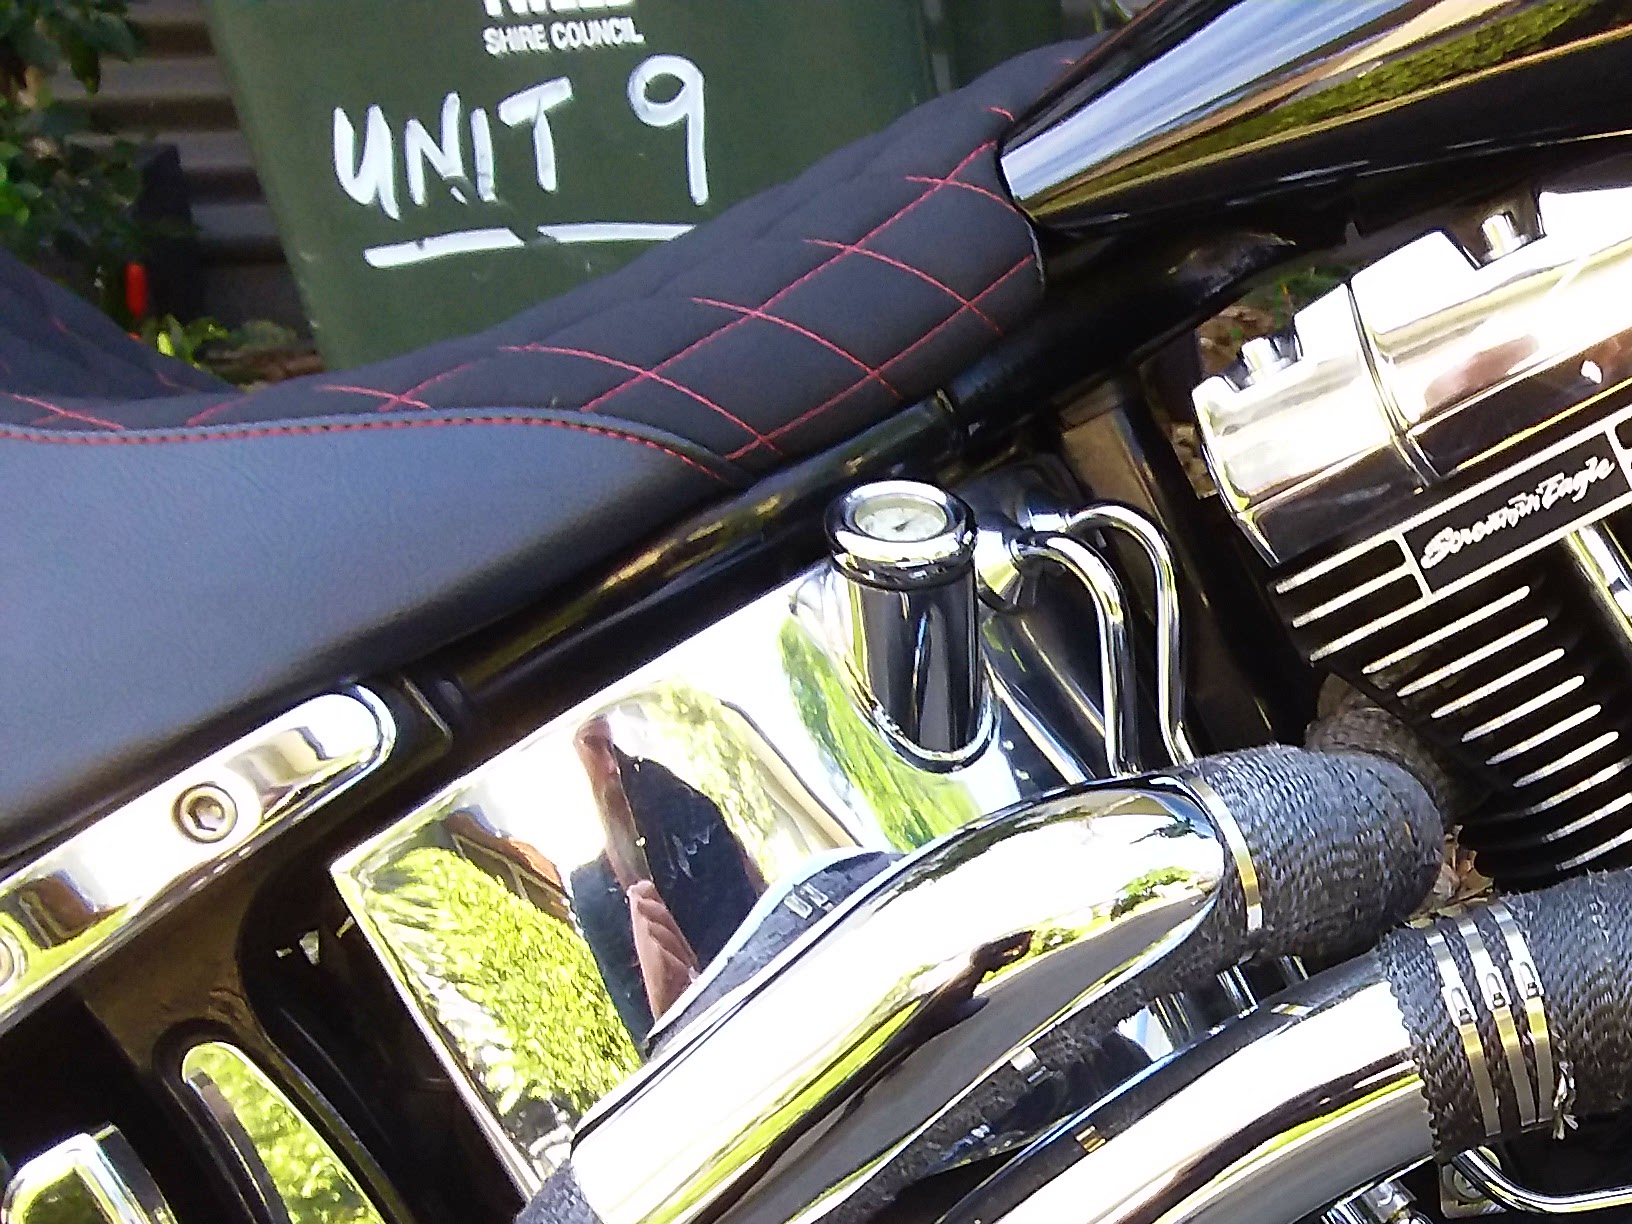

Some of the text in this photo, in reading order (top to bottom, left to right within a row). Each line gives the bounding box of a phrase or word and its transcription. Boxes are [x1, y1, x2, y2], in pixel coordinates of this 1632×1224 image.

[483, 16, 645, 55] SHIRE COUNCIL
[333, 54, 709, 220] UNIT 9
